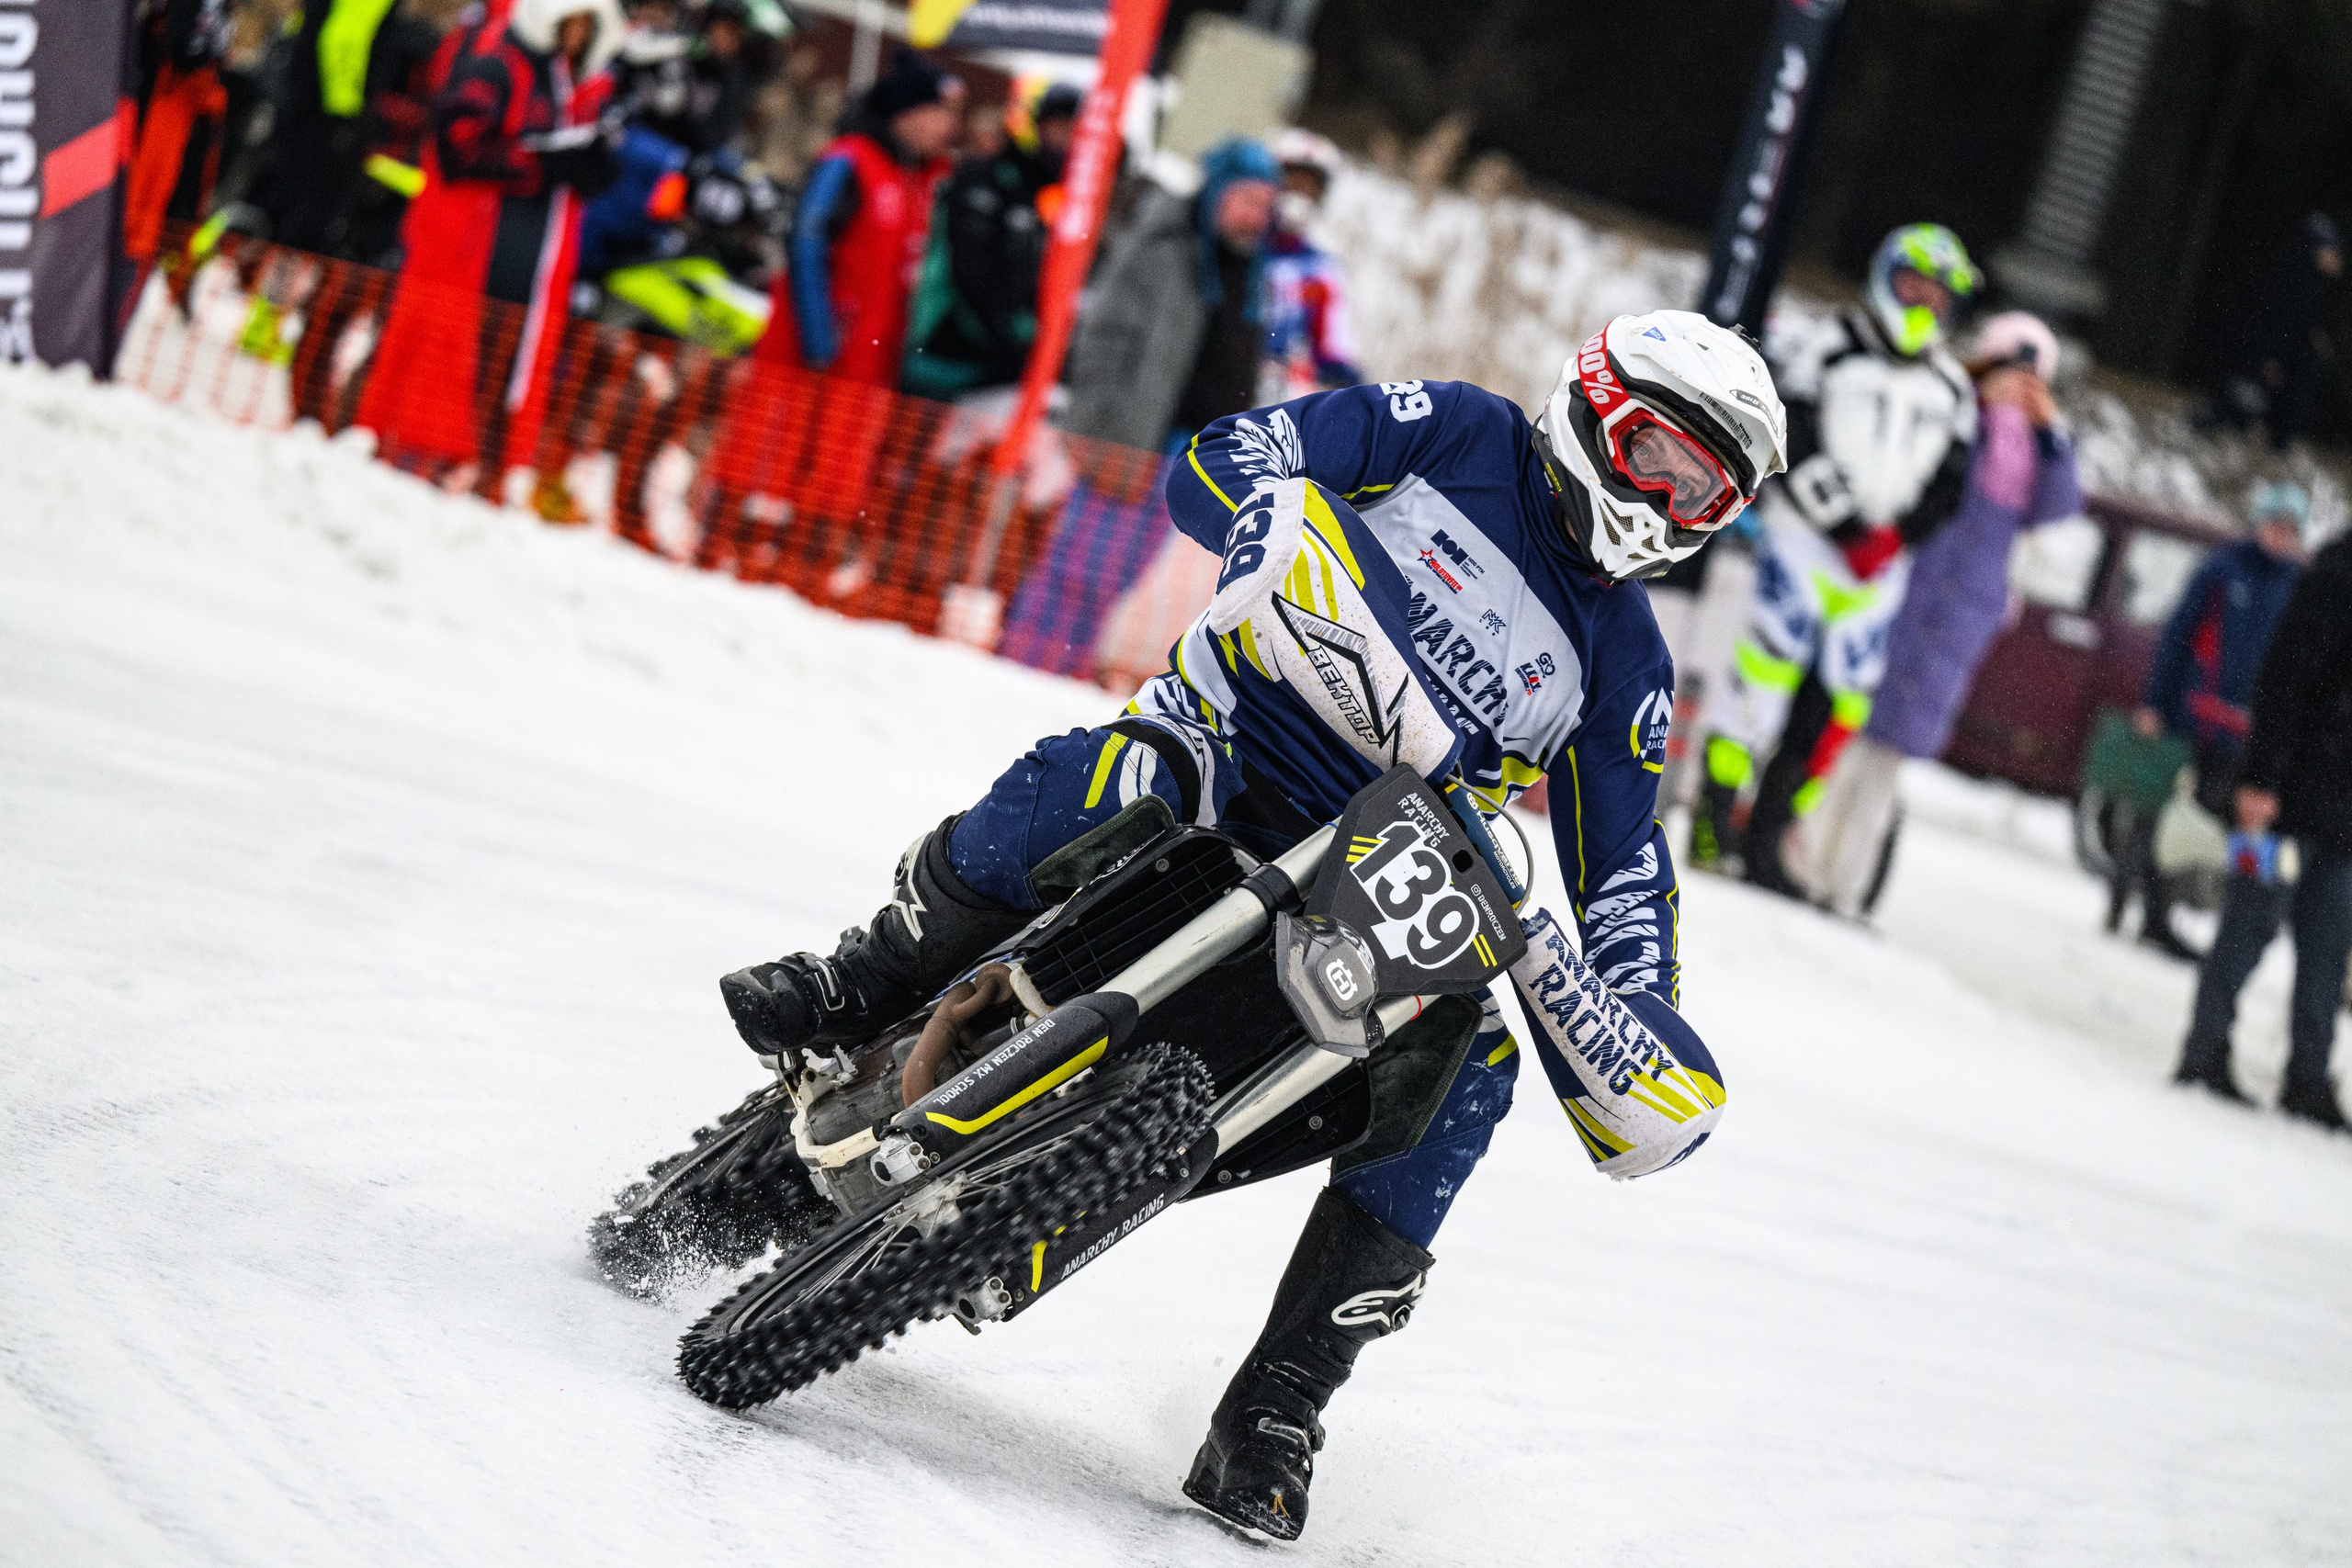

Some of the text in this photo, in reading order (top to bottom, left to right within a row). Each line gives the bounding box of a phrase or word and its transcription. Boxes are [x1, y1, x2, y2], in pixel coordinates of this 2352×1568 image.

[1216, 491, 1275, 595] 139
[1397, 797, 1442, 848] RACING
[1406, 792, 1450, 840] ANARCHY
[1351, 821, 1479, 968] 139
[1493, 850, 1516, 889] MOTORCYCLES
[1477, 894, 1506, 942] DENROCZEN
[933, 1019, 1056, 1106] DEN ROCZEN MX SCHOOL
[1528, 963, 1643, 1096] RACING
[1060, 1193, 1165, 1280] ANARCHY RACING
